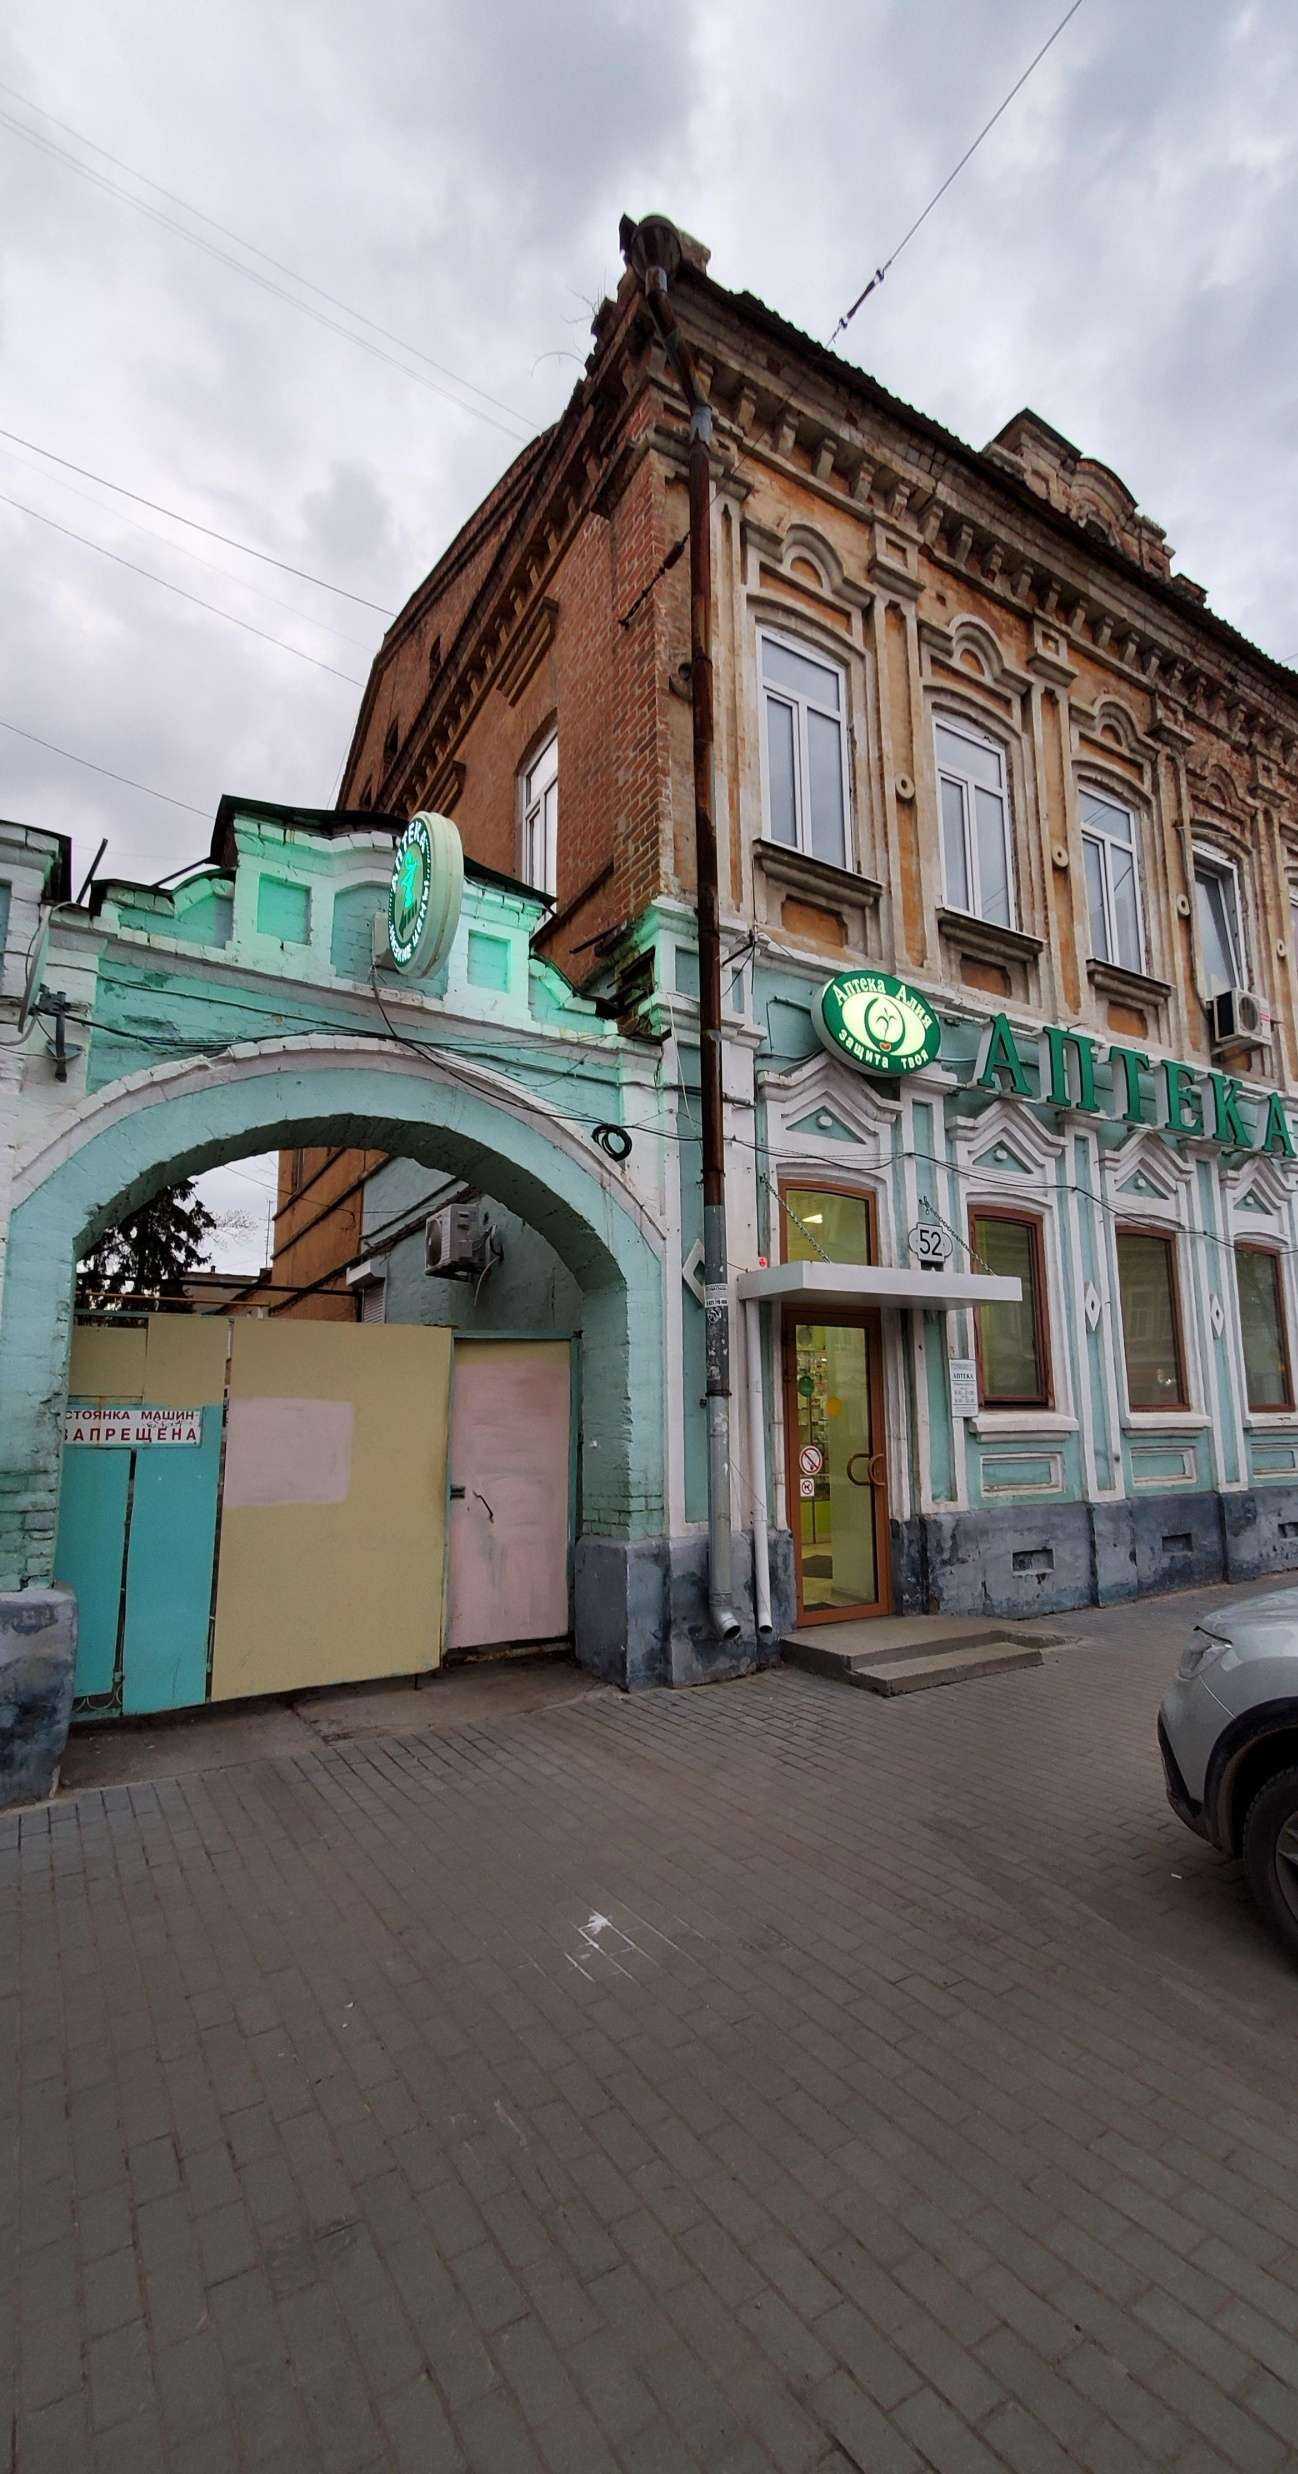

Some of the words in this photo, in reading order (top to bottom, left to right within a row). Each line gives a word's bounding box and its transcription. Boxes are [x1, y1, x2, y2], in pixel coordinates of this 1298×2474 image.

[391, 821, 428, 893] АПТЕКА
[832, 977, 886, 1007] Аптека
[838, 1028, 889, 1069] защита
[900, 1049, 929, 1070] твоя
[977, 1012, 1297, 1158] АПТЕКА
[919, 1229, 942, 1256] 52
[65, 1410, 130, 1420] СТОЯНКА
[140, 1410, 194, 1421] МАШИН
